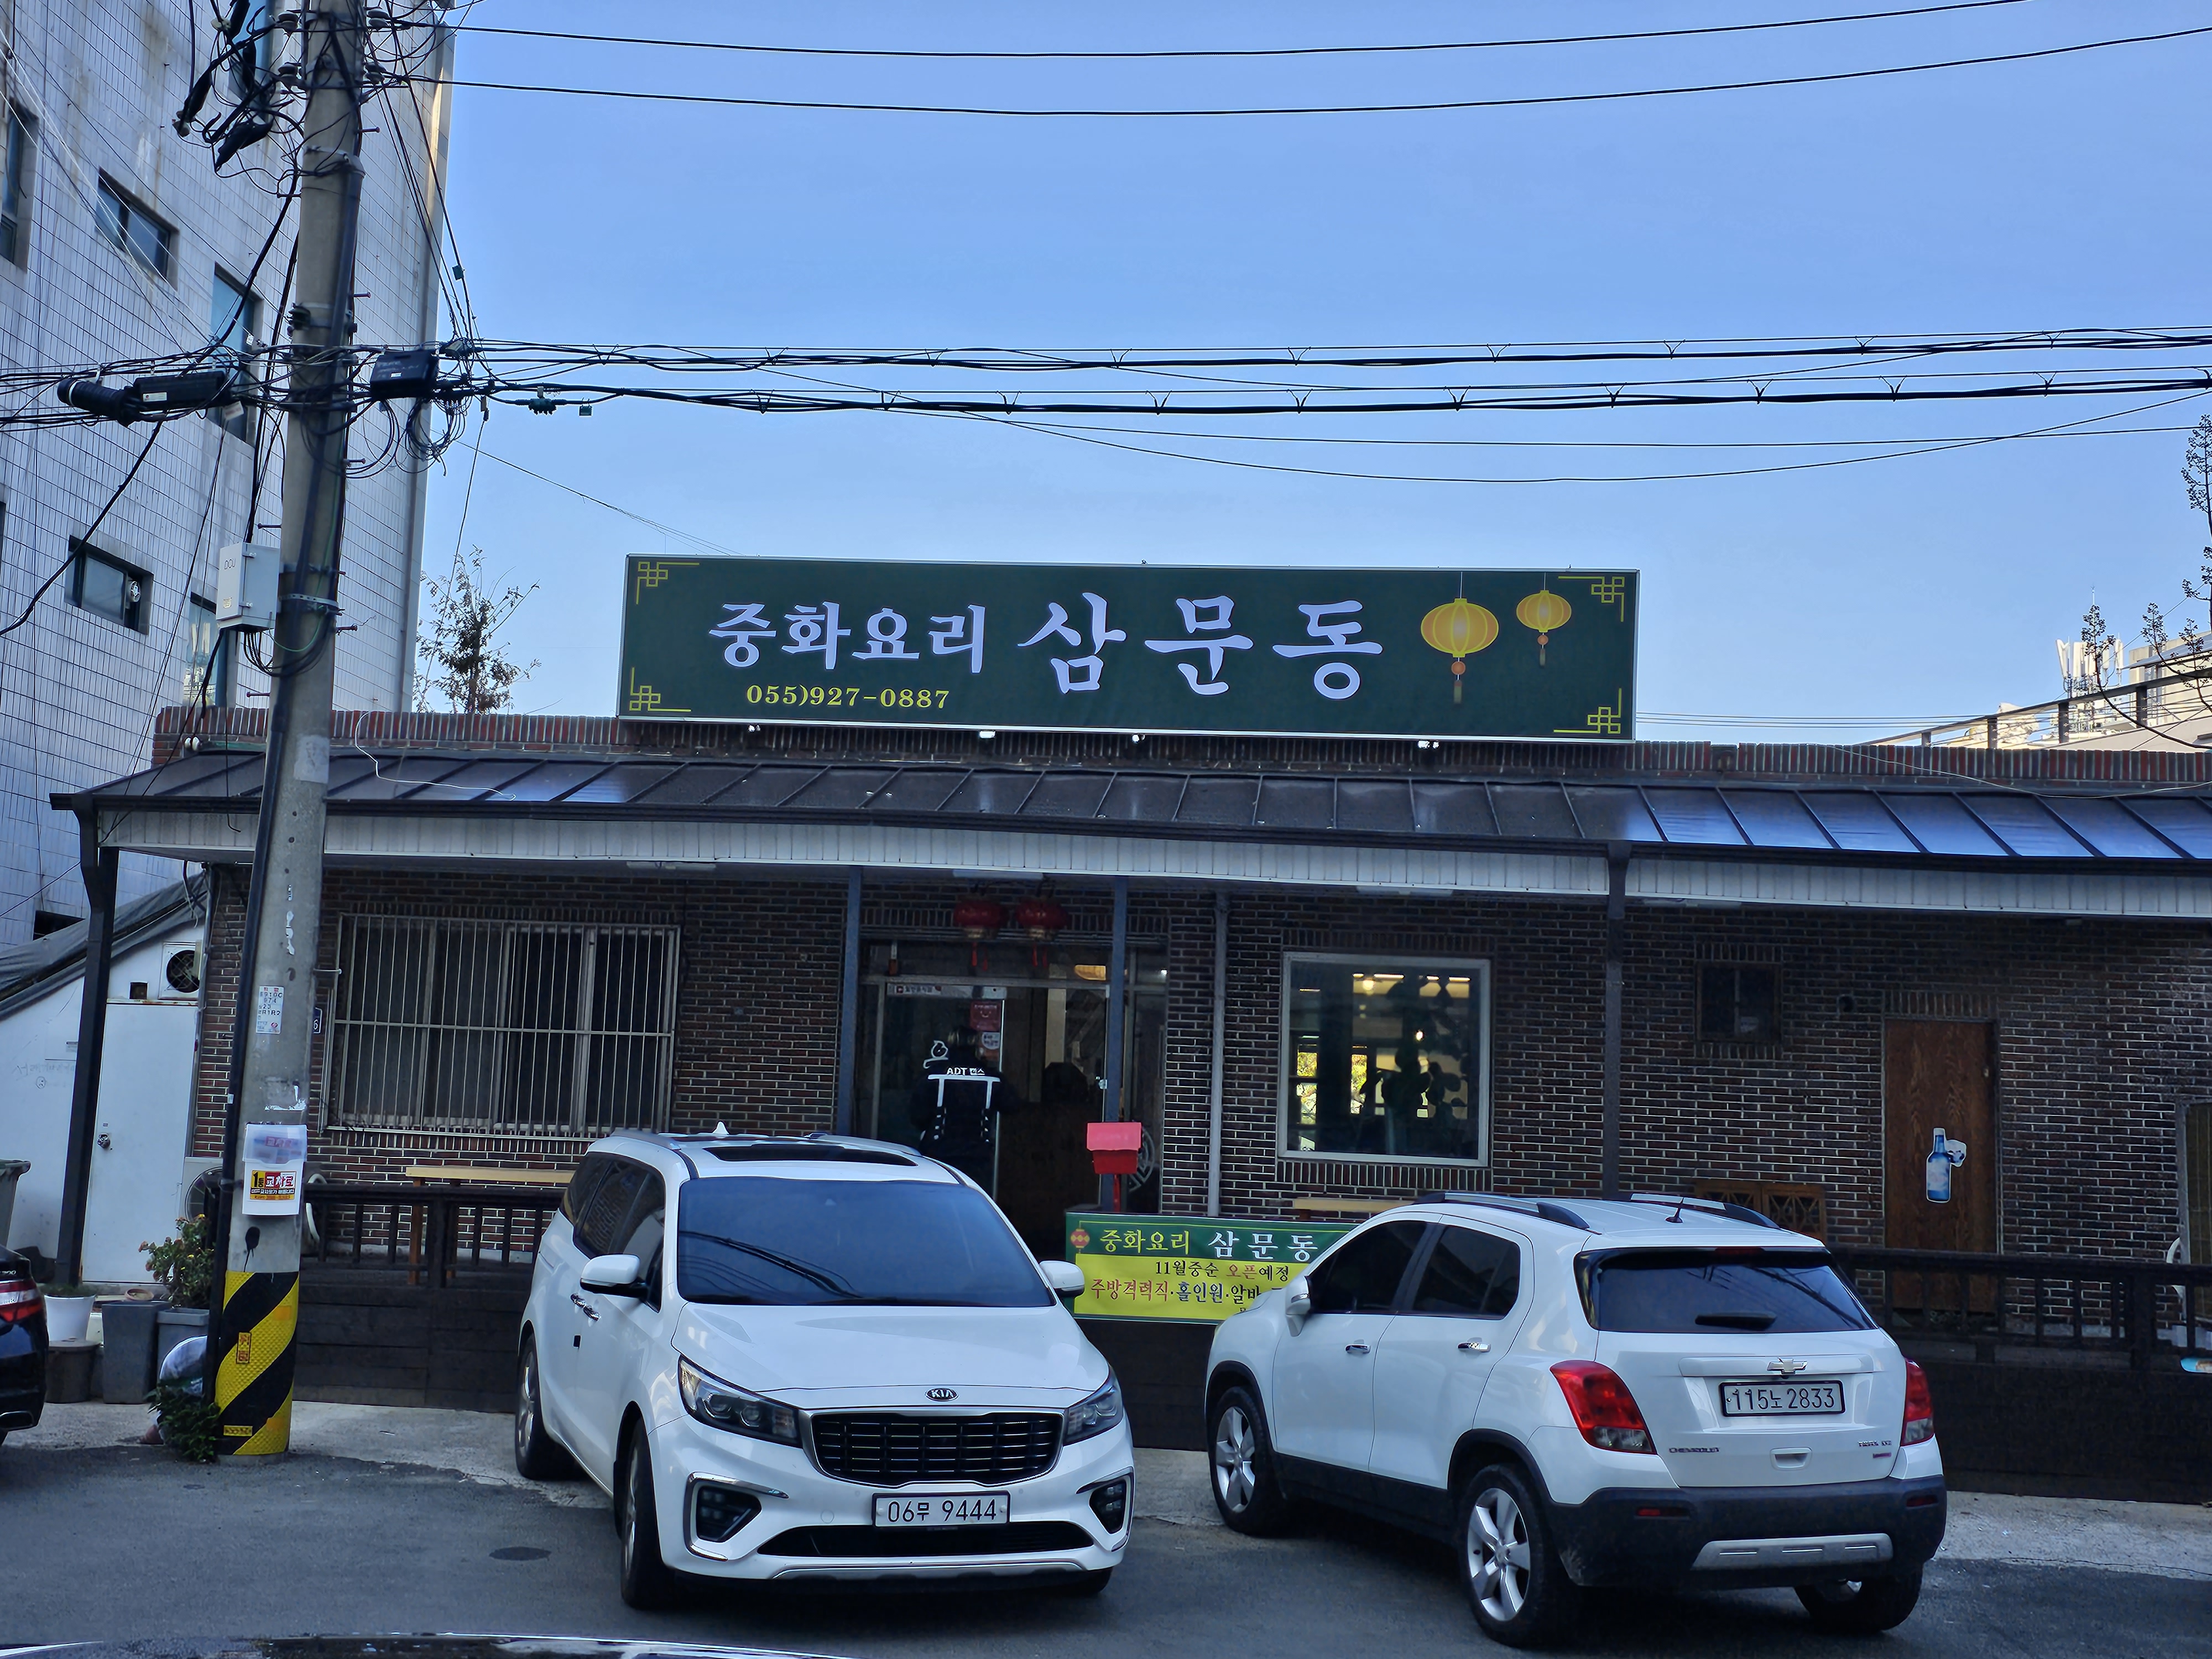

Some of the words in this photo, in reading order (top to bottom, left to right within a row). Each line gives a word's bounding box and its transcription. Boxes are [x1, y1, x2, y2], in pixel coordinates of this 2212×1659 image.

[708, 601, 985, 673] 중화요리
[747, 684, 950, 709] 055)927-0887
[947, 1067, 968, 1076] ADT
[1100, 1229, 1190, 1255] 중화요리
[1226, 1264, 1289, 1282] 오픈예정
[888, 1501, 930, 1522] 06무
[942, 1499, 997, 1521] 9444
